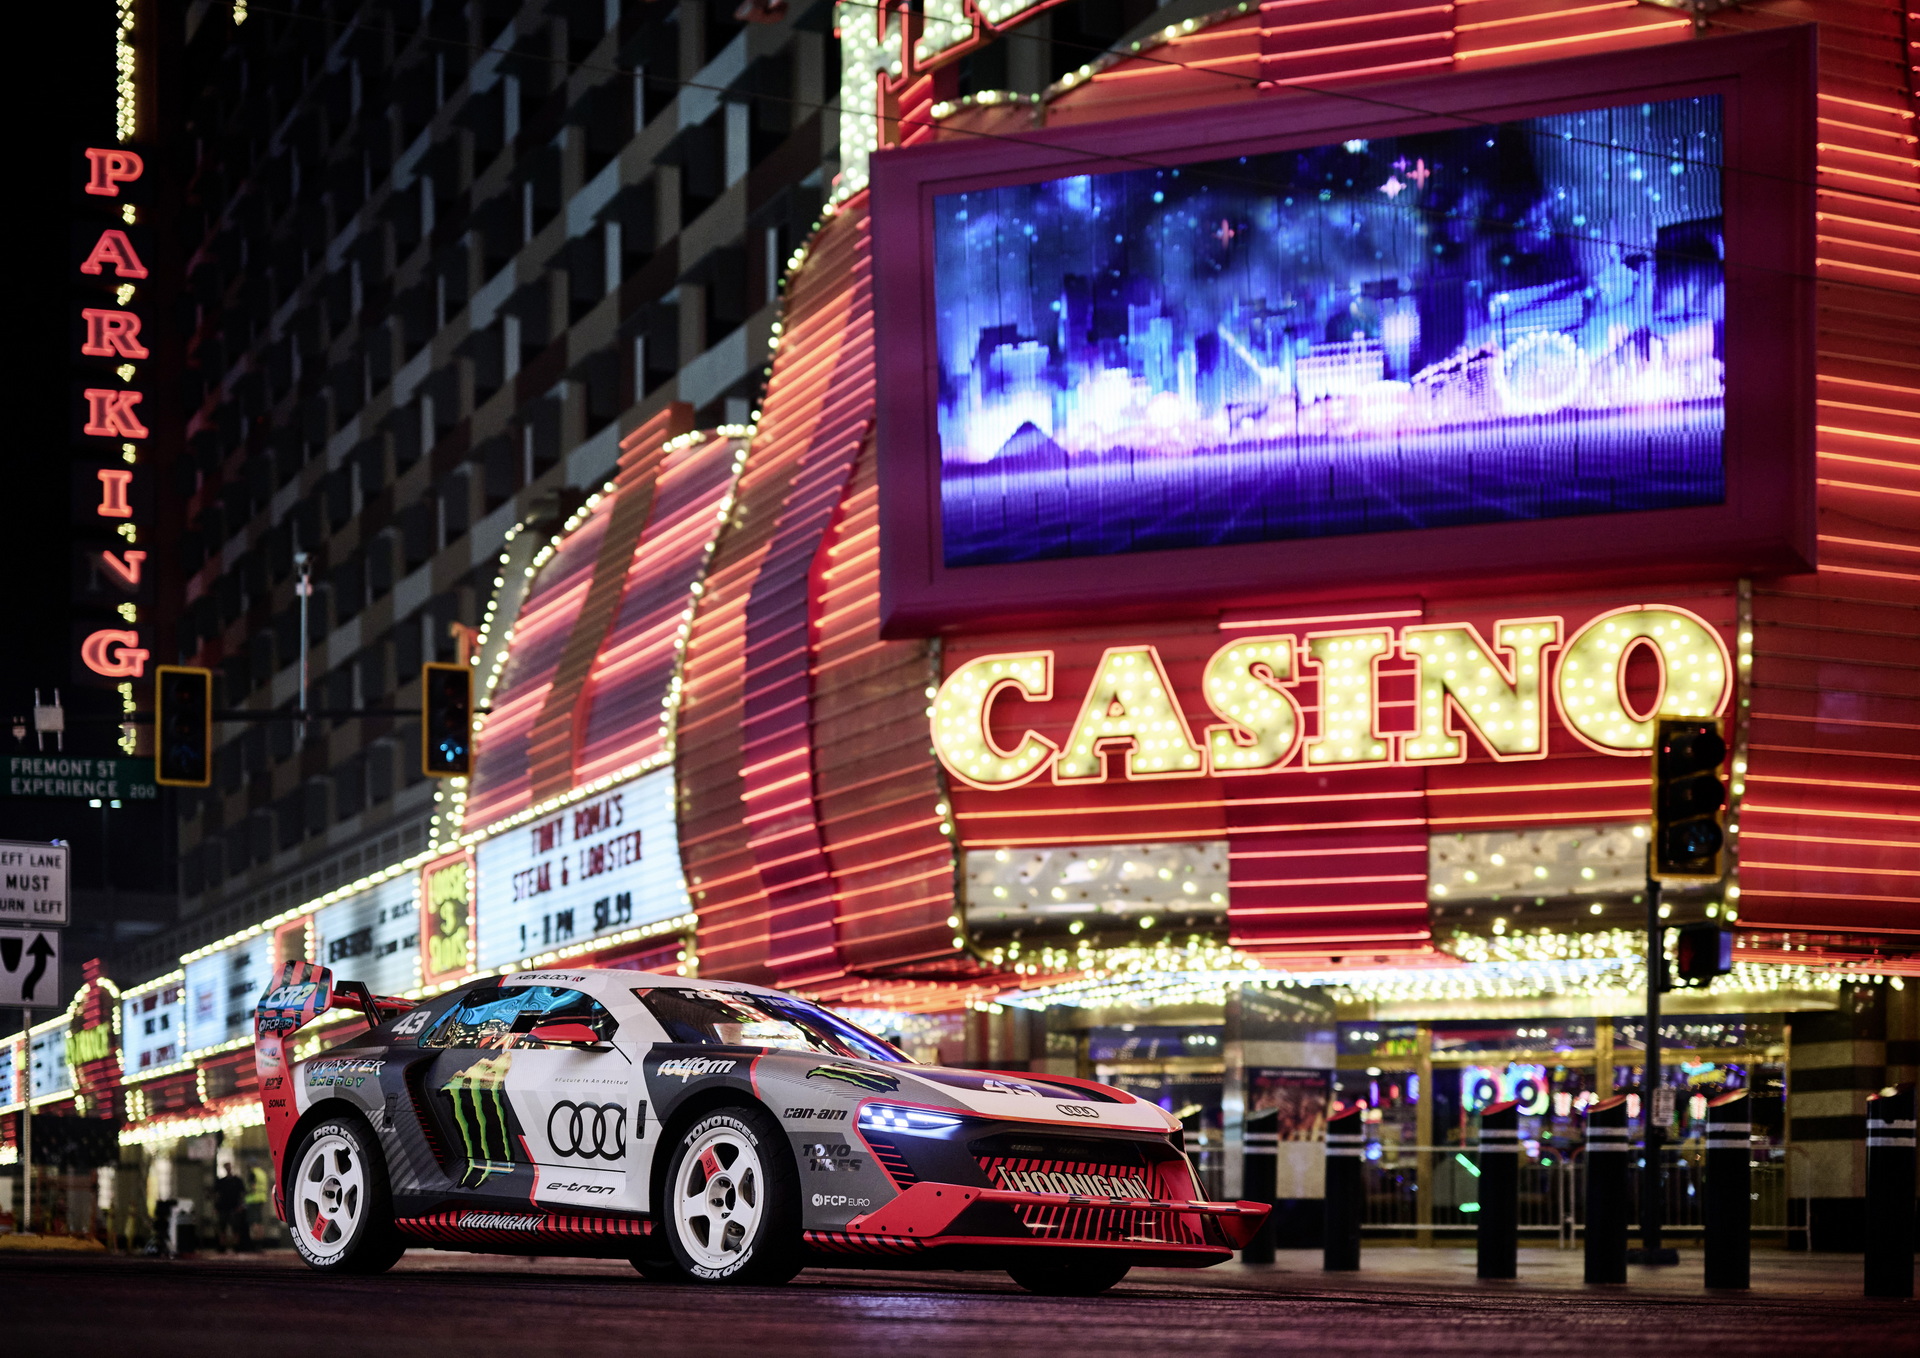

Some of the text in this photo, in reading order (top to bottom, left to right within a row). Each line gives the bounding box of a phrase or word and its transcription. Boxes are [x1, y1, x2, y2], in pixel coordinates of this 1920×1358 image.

[80, 147, 150, 678] PARKING
[929, 604, 1733, 791] CASINO
[11, 757, 117, 778] FREMONT ST
[11, 777, 118, 798] EXPERIENCE
[0, 852, 62, 869] EFT LANE
[6, 873, 50, 892] MUST
[0, 900, 62, 914] URN LEFT
[266, 982, 318, 1009] CSR2
[265, 1018, 279, 1030] FCP
[391, 1010, 432, 1035] 43
[306, 1059, 386, 1077] MONSTER
[309, 1076, 365, 1088] ENERGY
[268, 1098, 286, 1108] SONAX
[783, 1108, 848, 1121] can-am
[802, 1143, 852, 1157] TOYO
[809, 1158, 862, 1172] TIRES
[546, 1181, 616, 1195] e-tron
[823, 1195, 871, 1207] FCP EURO
